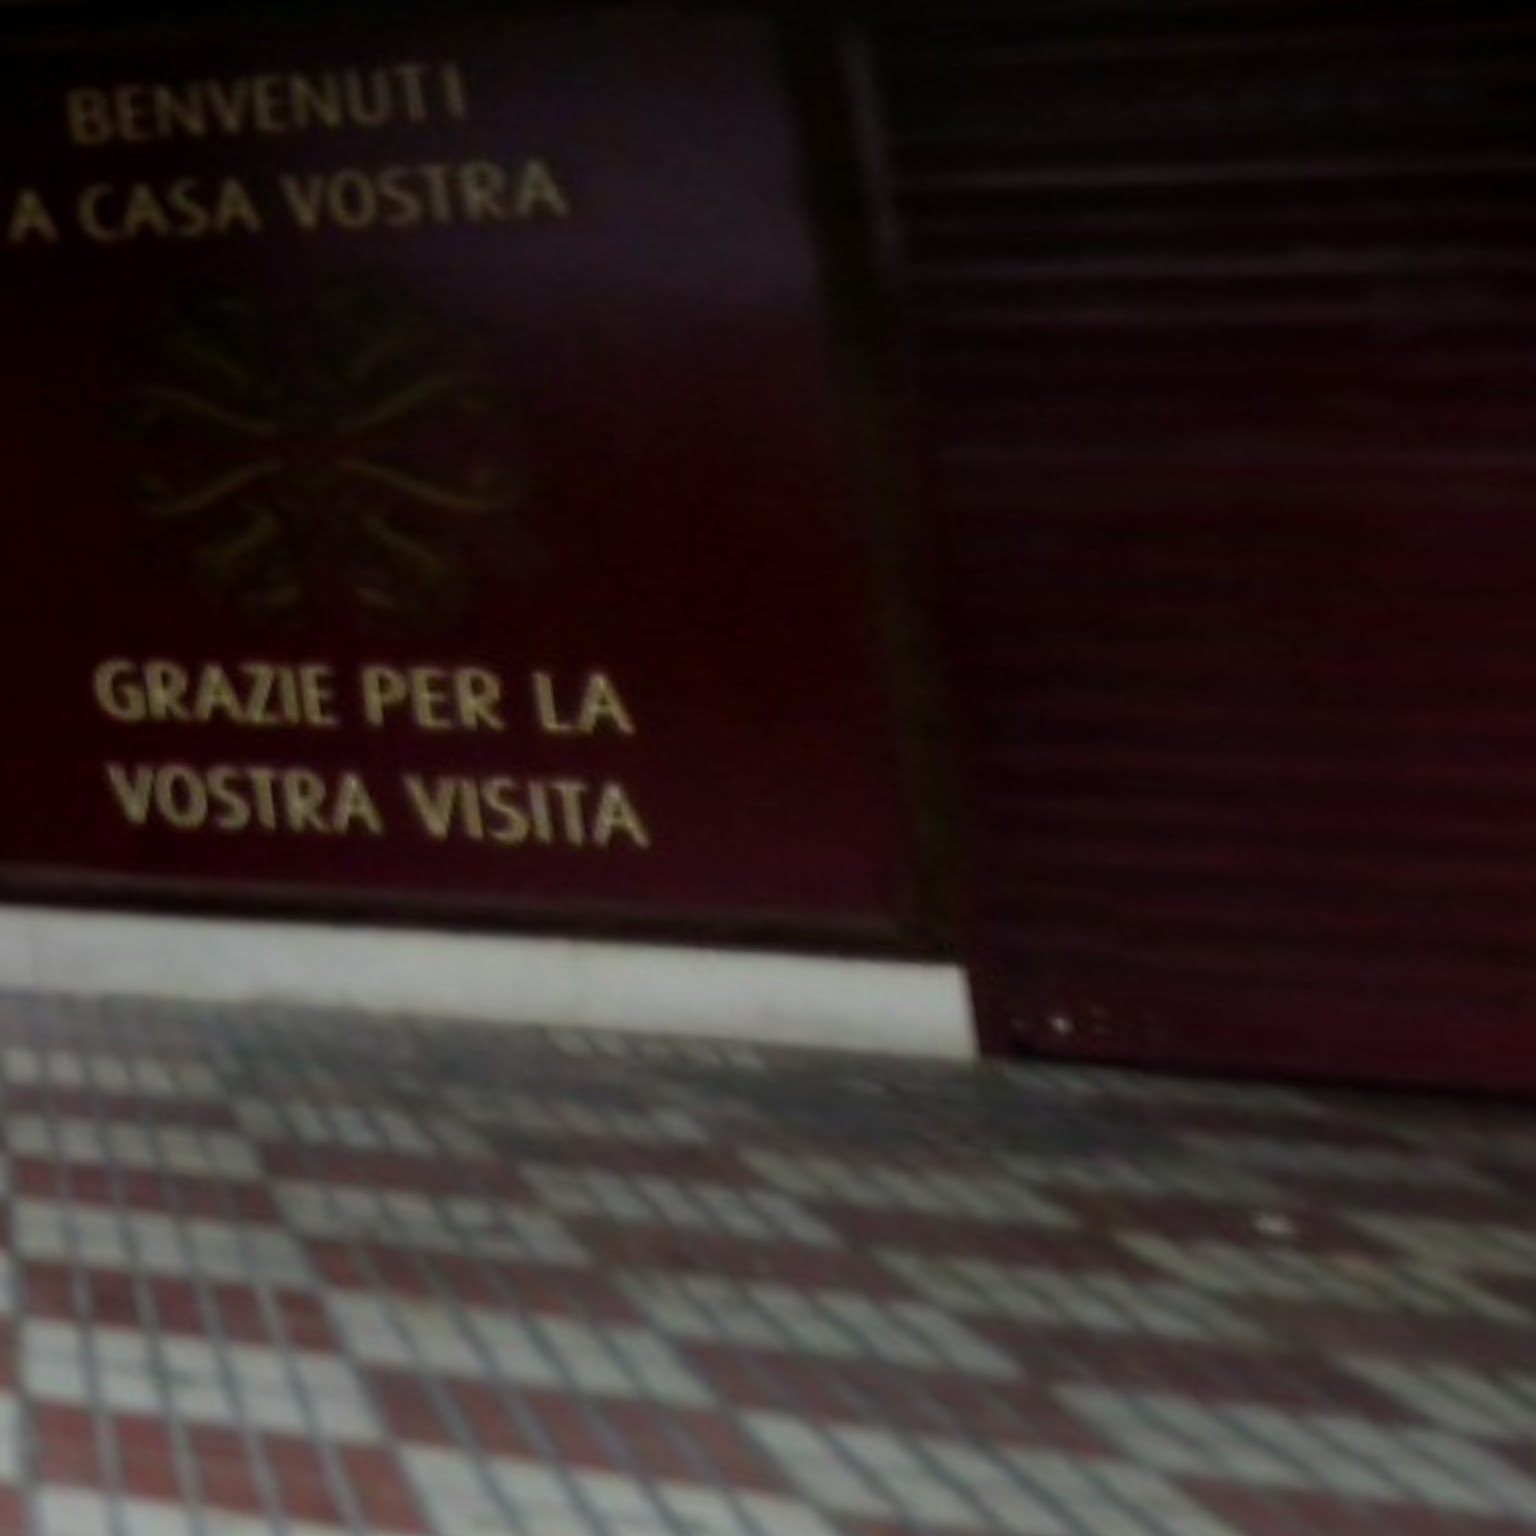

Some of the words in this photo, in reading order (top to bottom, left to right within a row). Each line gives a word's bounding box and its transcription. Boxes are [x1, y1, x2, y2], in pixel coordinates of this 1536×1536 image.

[65, 61, 467, 148] BENVENUTI
[5, 187, 60, 247] A
[76, 171, 265, 247] CASA
[281, 158, 567, 233] VOSTRA
[91, 658, 342, 728] GRAZIE
[357, 658, 505, 734] PER
[533, 666, 636, 738] LA
[105, 761, 384, 837] VOSTRA
[401, 775, 651, 853] VISITA
